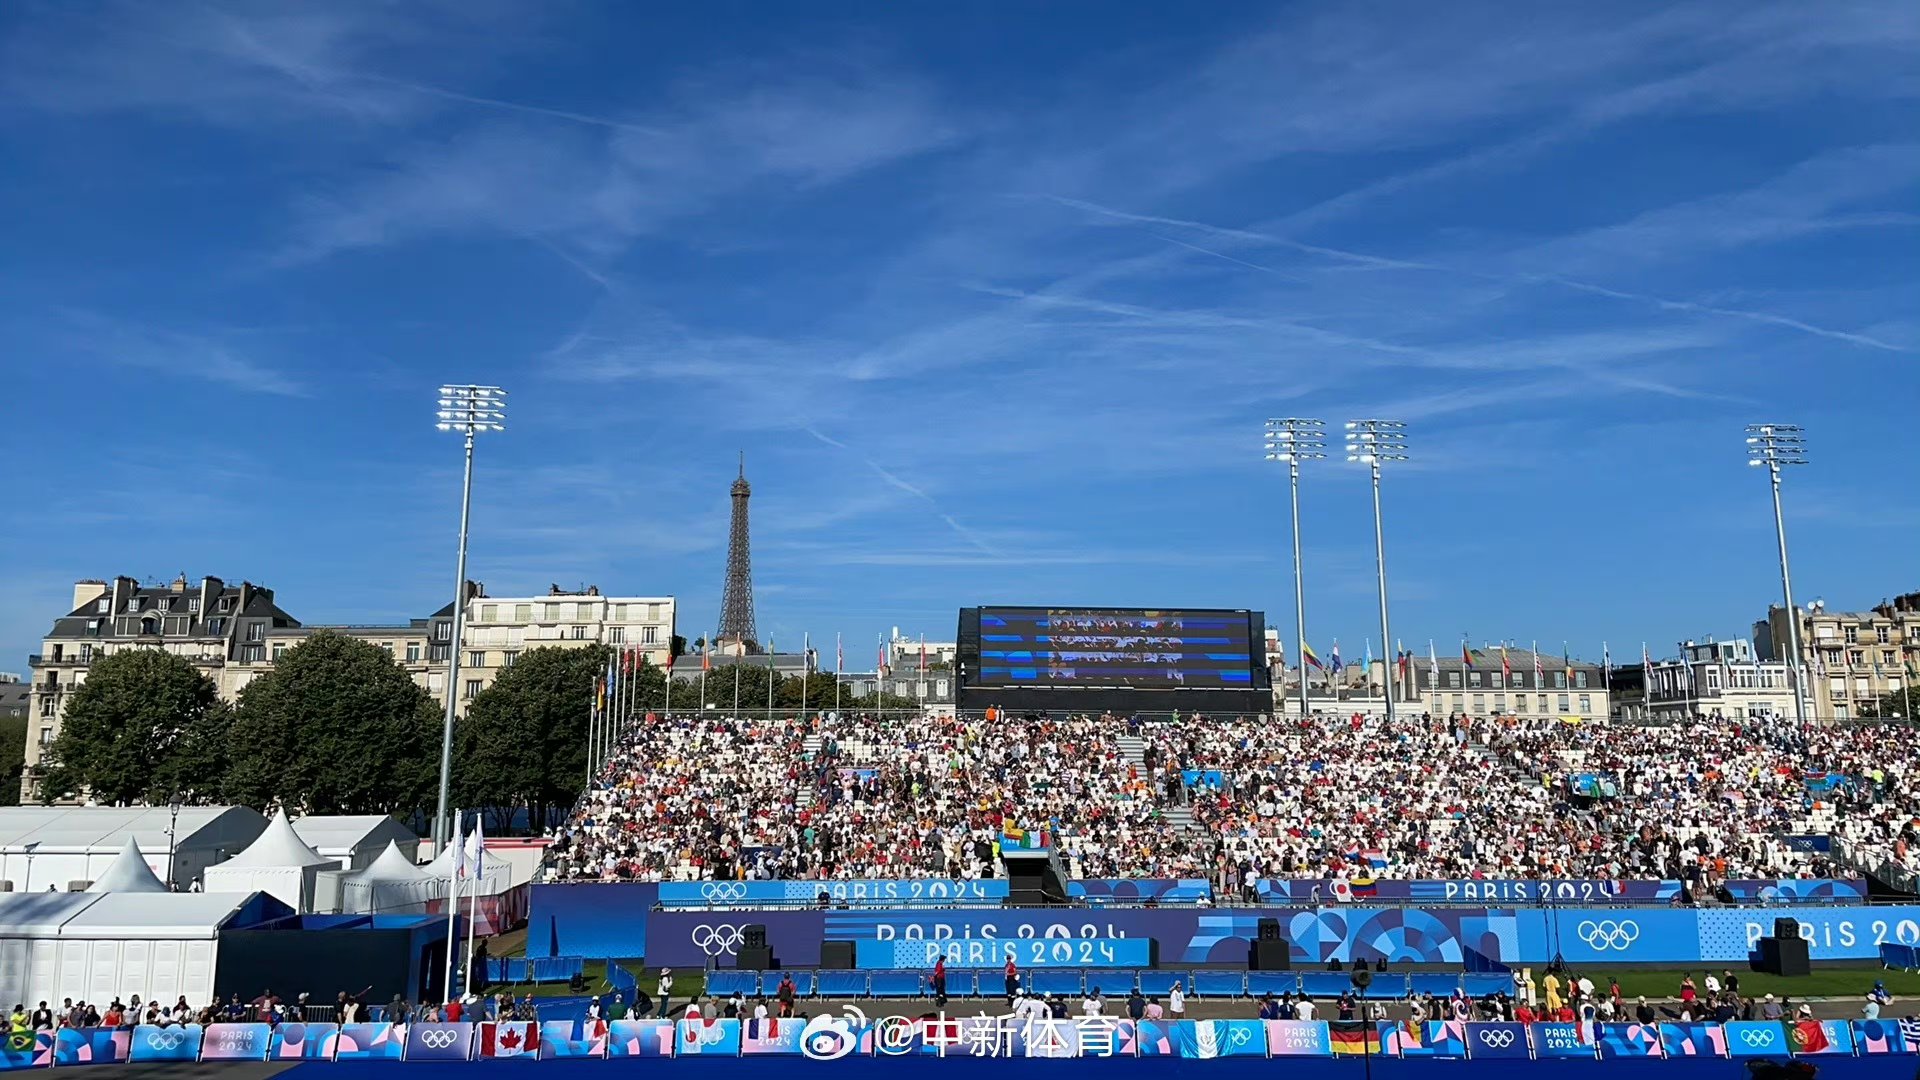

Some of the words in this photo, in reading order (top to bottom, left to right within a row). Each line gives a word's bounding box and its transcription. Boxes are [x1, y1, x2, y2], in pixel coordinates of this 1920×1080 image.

[910, 882, 986, 901] 2024
[1540, 882, 1612, 901] 2024
[1031, 941, 1115, 963] 2024
[220, 1030, 254, 1040] PARIS
[1284, 1027, 1317, 1038] PARIS
[1544, 1027, 1578, 1039] PARIS
[218, 1041, 252, 1051] 2024
[758, 1036, 791, 1047] 2024
[1286, 1038, 1319, 1049] 2024
[1547, 1038, 1580, 1049] 2024
